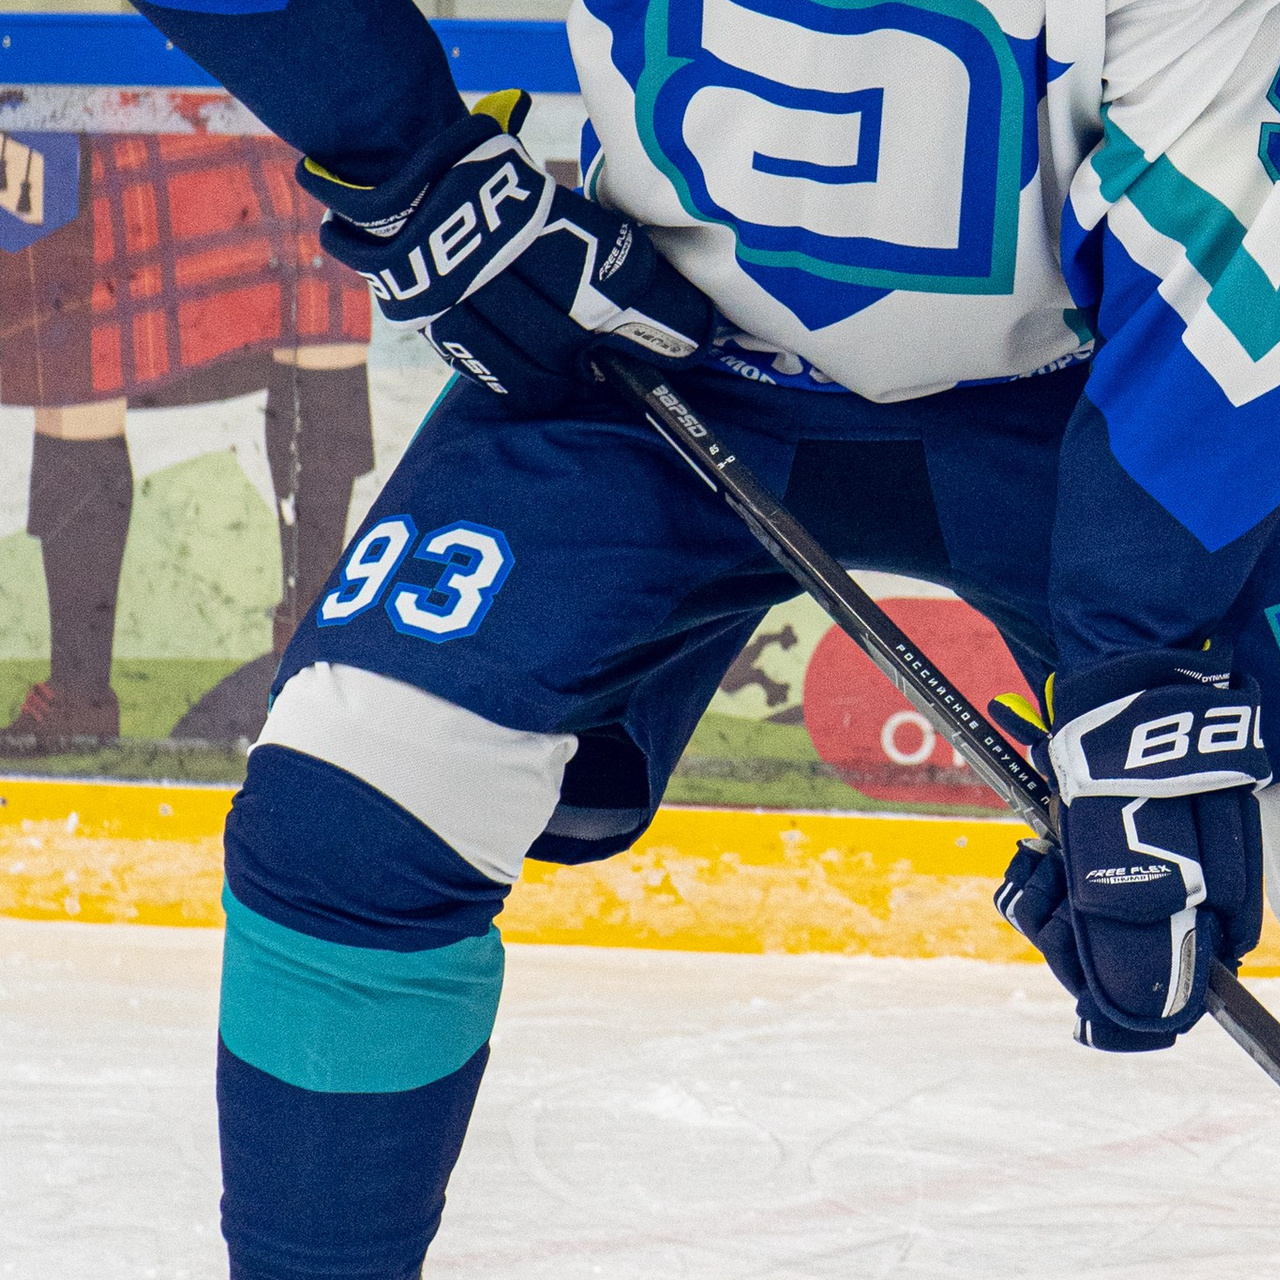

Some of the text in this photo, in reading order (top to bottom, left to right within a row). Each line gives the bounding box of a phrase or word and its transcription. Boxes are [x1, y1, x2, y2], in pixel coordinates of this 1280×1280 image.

[599, 222, 630, 281] FREE FLEX
[319, 516, 511, 640] 93
[984, 735, 1038, 791] ОРУЖИЕ
[1086, 863, 1172, 880] FREE FLEX
